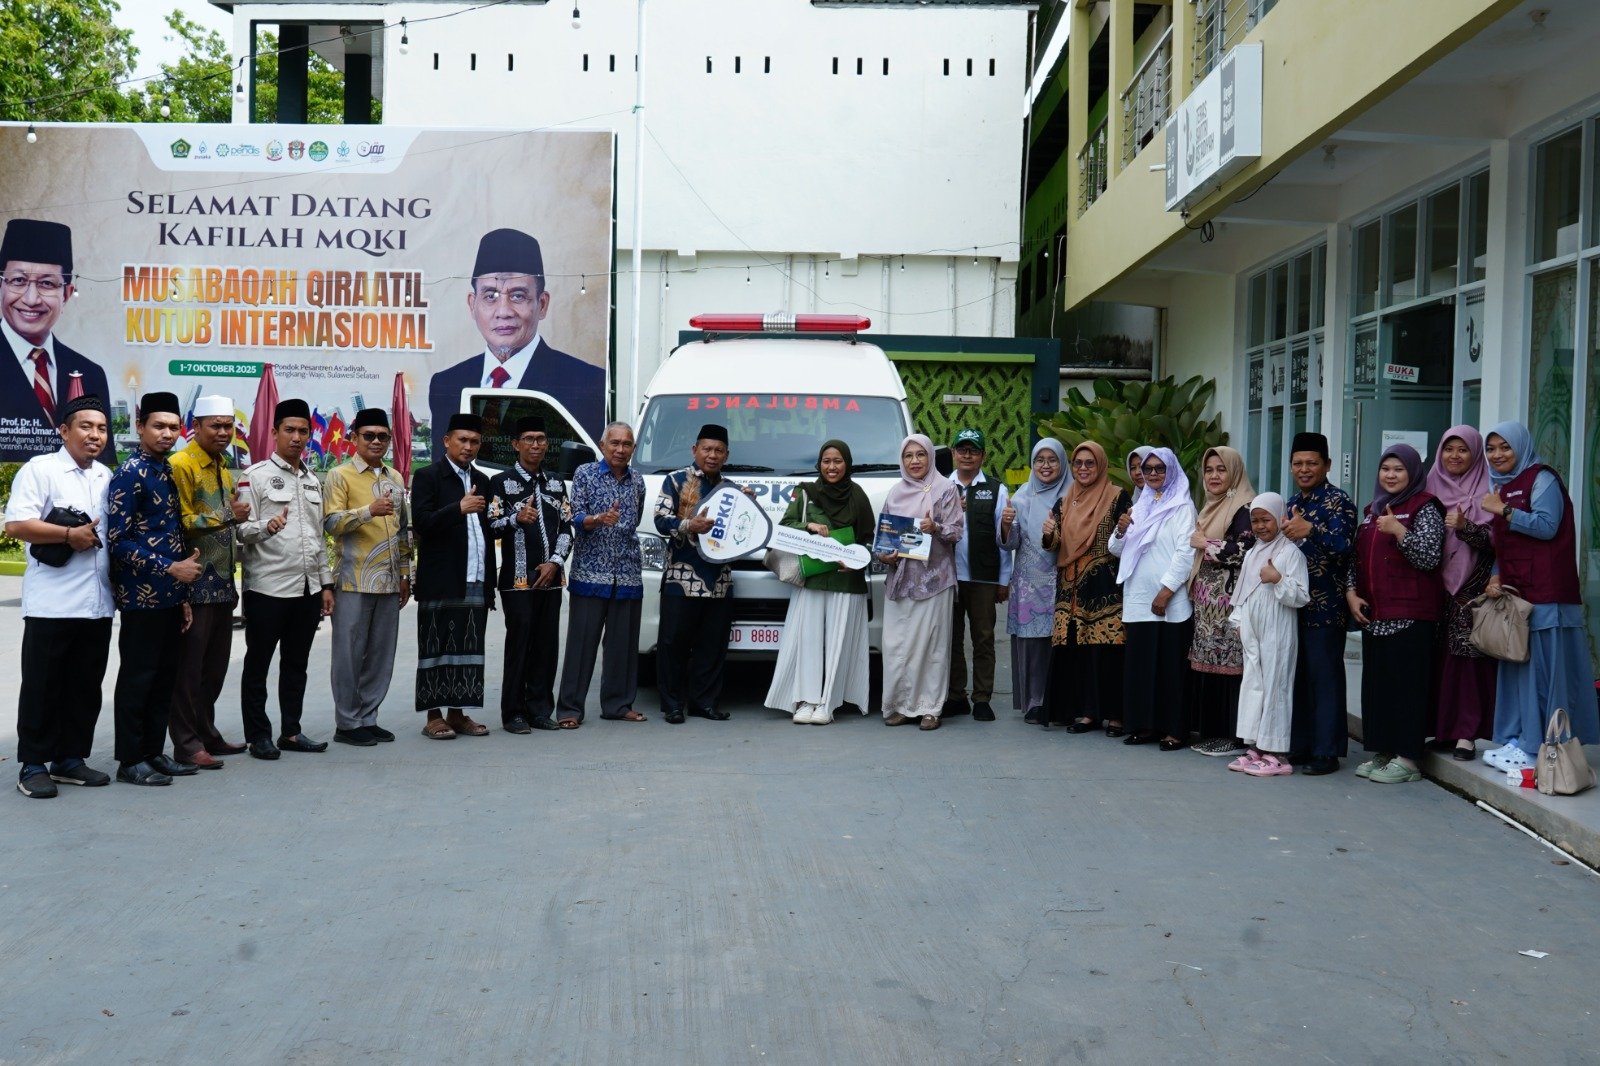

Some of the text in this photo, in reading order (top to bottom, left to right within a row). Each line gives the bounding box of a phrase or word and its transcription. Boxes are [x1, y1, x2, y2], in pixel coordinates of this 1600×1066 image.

[126, 190, 433, 219] SELAMAT DATANG
[158, 222, 408, 257] KAFILAH MQKI
[123, 266, 428, 309] MUSABAQAH QIRAATIL
[126, 307, 433, 350] KUTUB INTERNASIONAL
[193, 364, 235, 373] OKTOBER
[236, 365, 257, 374] 2025
[274, 363, 299, 371] Pondok
[1388, 365, 1414, 376] BUKA
[1, 418, 42, 427] Prof. Dr. H.
[0, 427, 31, 435] aruddin
[31, 427, 55, 436] Umar.
[11, 436, 34, 444] Agama
[23, 444, 55, 452] As'adiyah
[748, 483, 796, 504] PK
[711, 493, 735, 540] BPKH
[777, 531, 803, 544] PROGRAM
[751, 629, 779, 643] 8888
